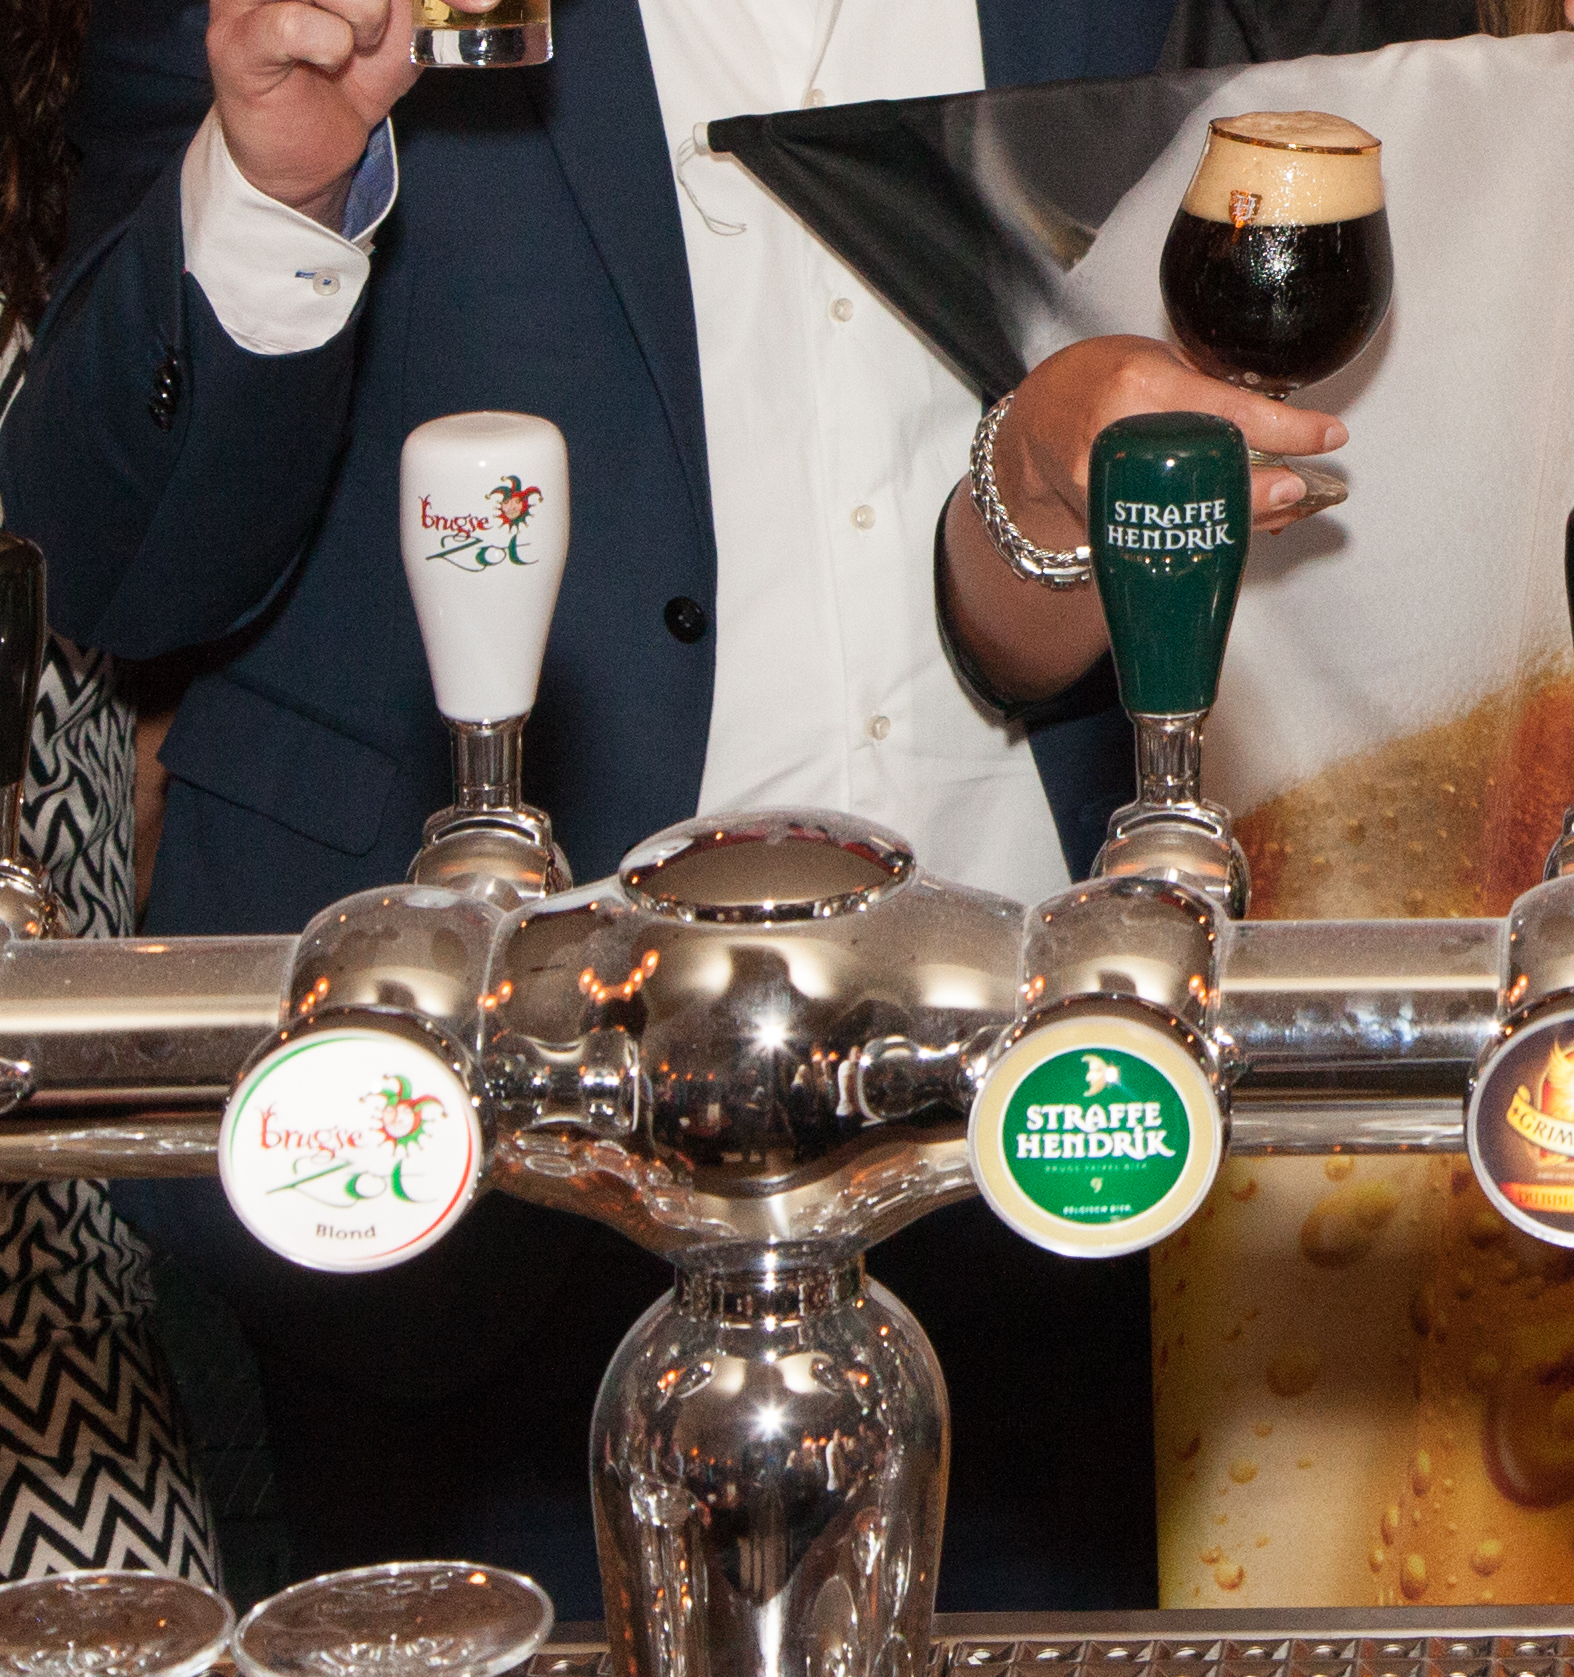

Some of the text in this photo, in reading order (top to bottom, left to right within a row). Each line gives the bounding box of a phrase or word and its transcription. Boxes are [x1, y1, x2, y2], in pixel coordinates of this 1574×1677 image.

[418, 493, 493, 541] brugse
[1114, 499, 1227, 528] STRAFFE
[425, 533, 539, 572] Zot
[1107, 521, 1236, 550] HENDRIK
[256, 1102, 369, 1164] brugse
[1026, 1101, 1163, 1133] STRAFFE
[1016, 1124, 1176, 1160] HENDRIK
[265, 1159, 438, 1208] Zot
[316, 1223, 377, 1240] Blond
